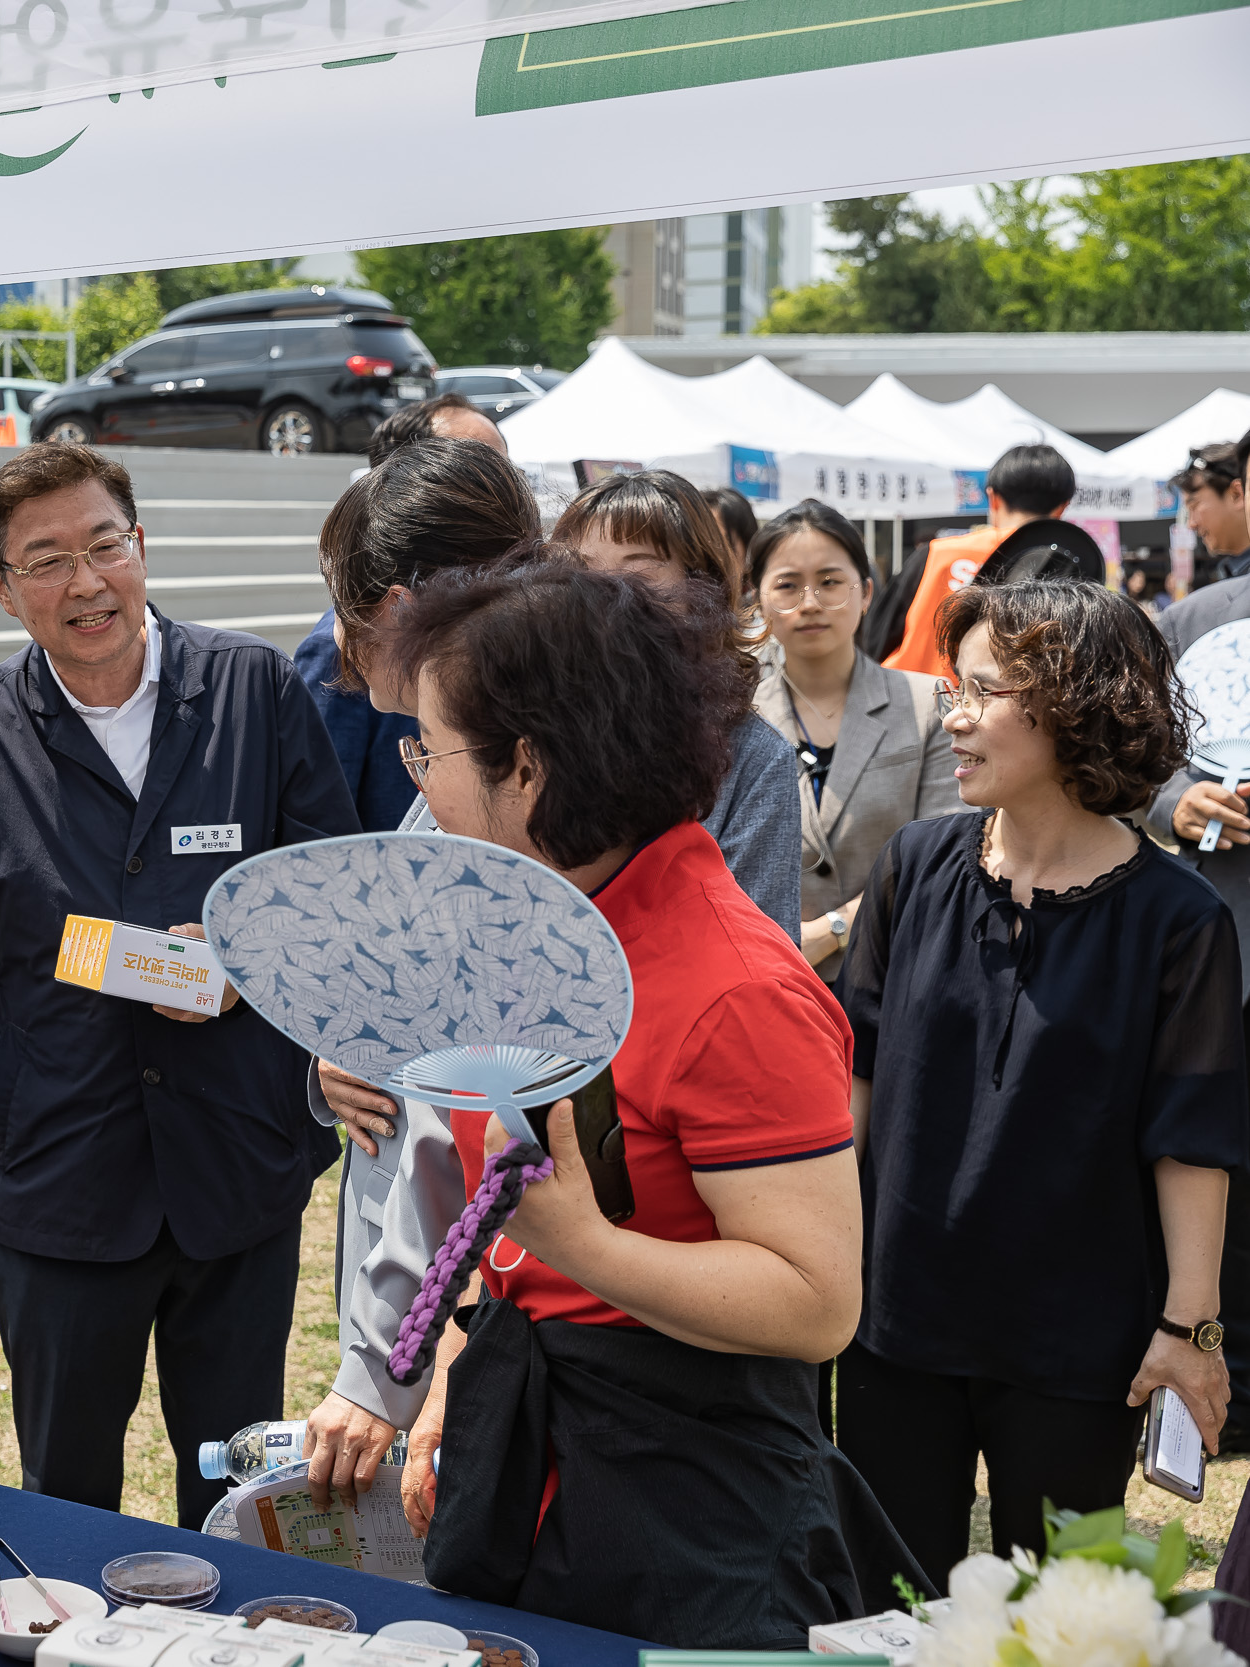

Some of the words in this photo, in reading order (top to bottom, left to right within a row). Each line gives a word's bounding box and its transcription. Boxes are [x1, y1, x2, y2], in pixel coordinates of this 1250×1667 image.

[123, 951, 166, 976] 펫치즈
[168, 959, 210, 984] 짜먹는
[143, 975, 170, 986] CHEESE
[169, 981, 183, 990] PET
[195, 996, 215, 1008] LAB
